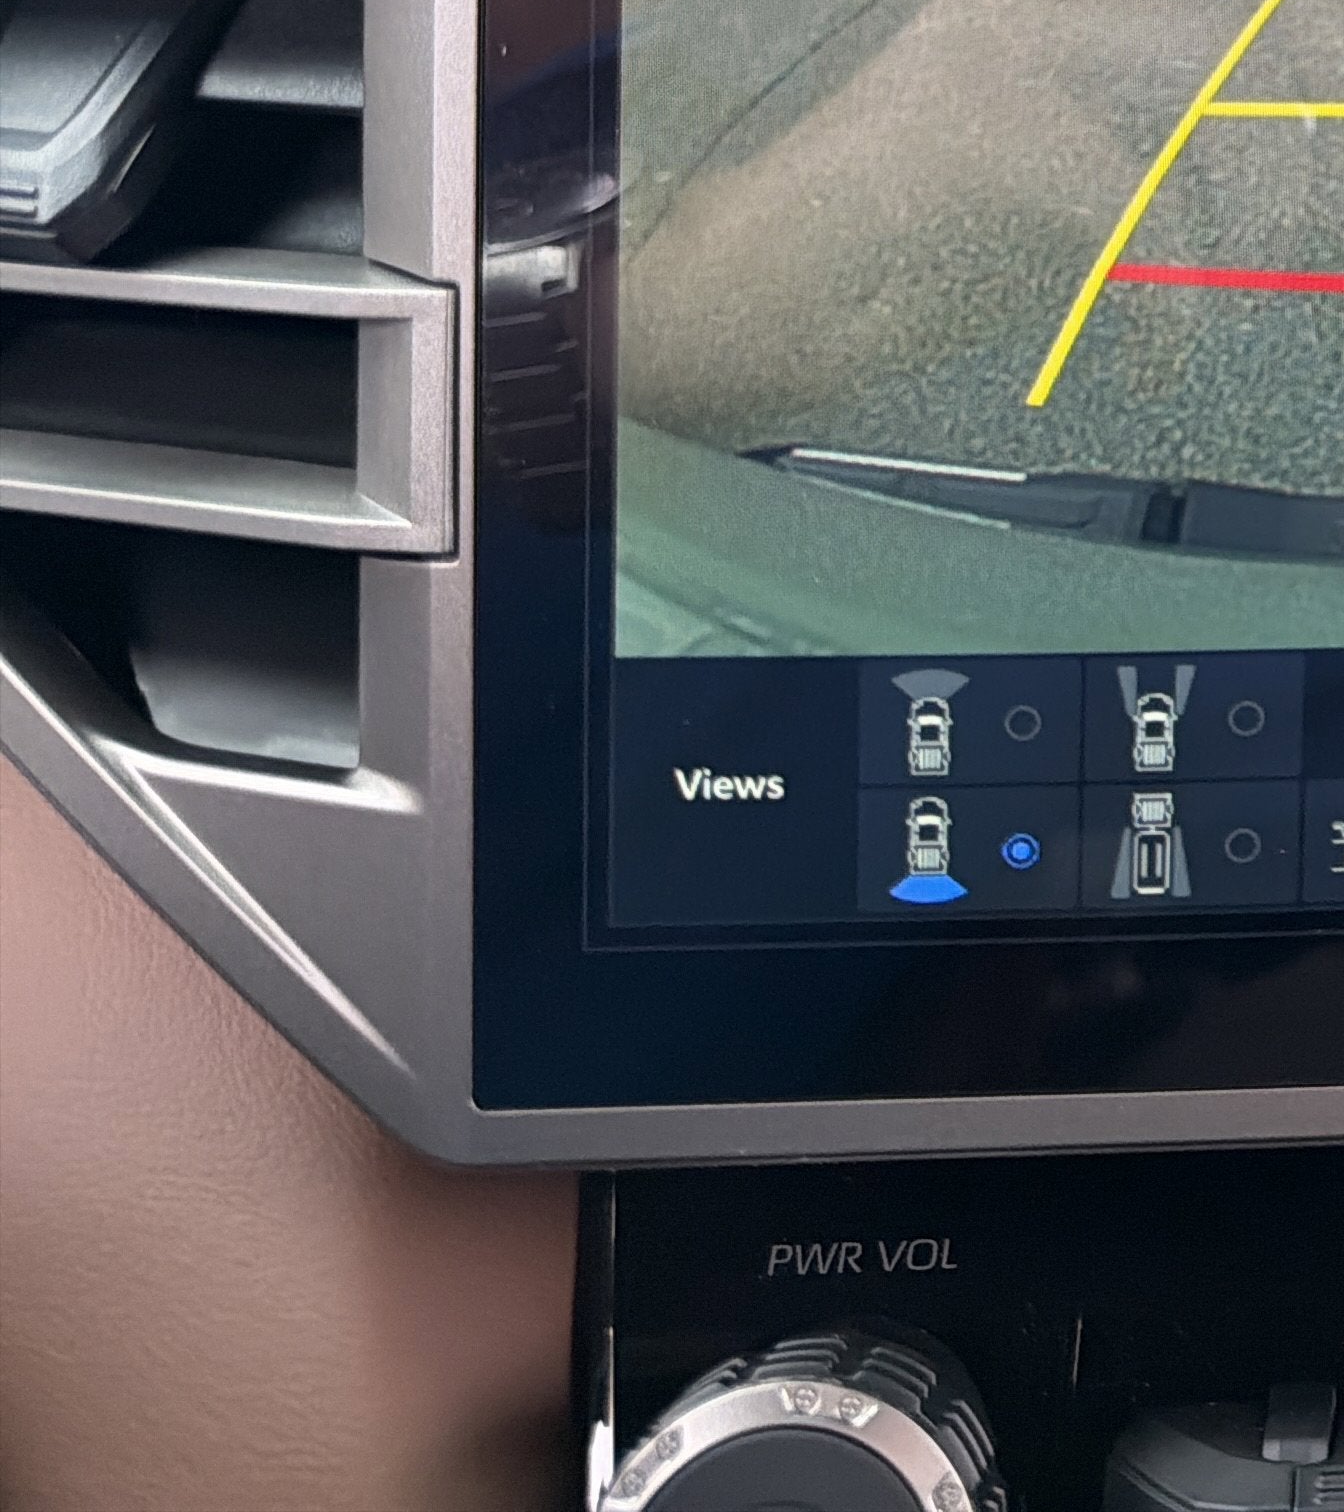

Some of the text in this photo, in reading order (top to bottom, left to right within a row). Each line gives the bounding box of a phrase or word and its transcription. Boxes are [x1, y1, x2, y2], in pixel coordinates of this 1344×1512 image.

[674, 767, 786, 802] Views
[767, 1238, 959, 1277] PWR VOL
